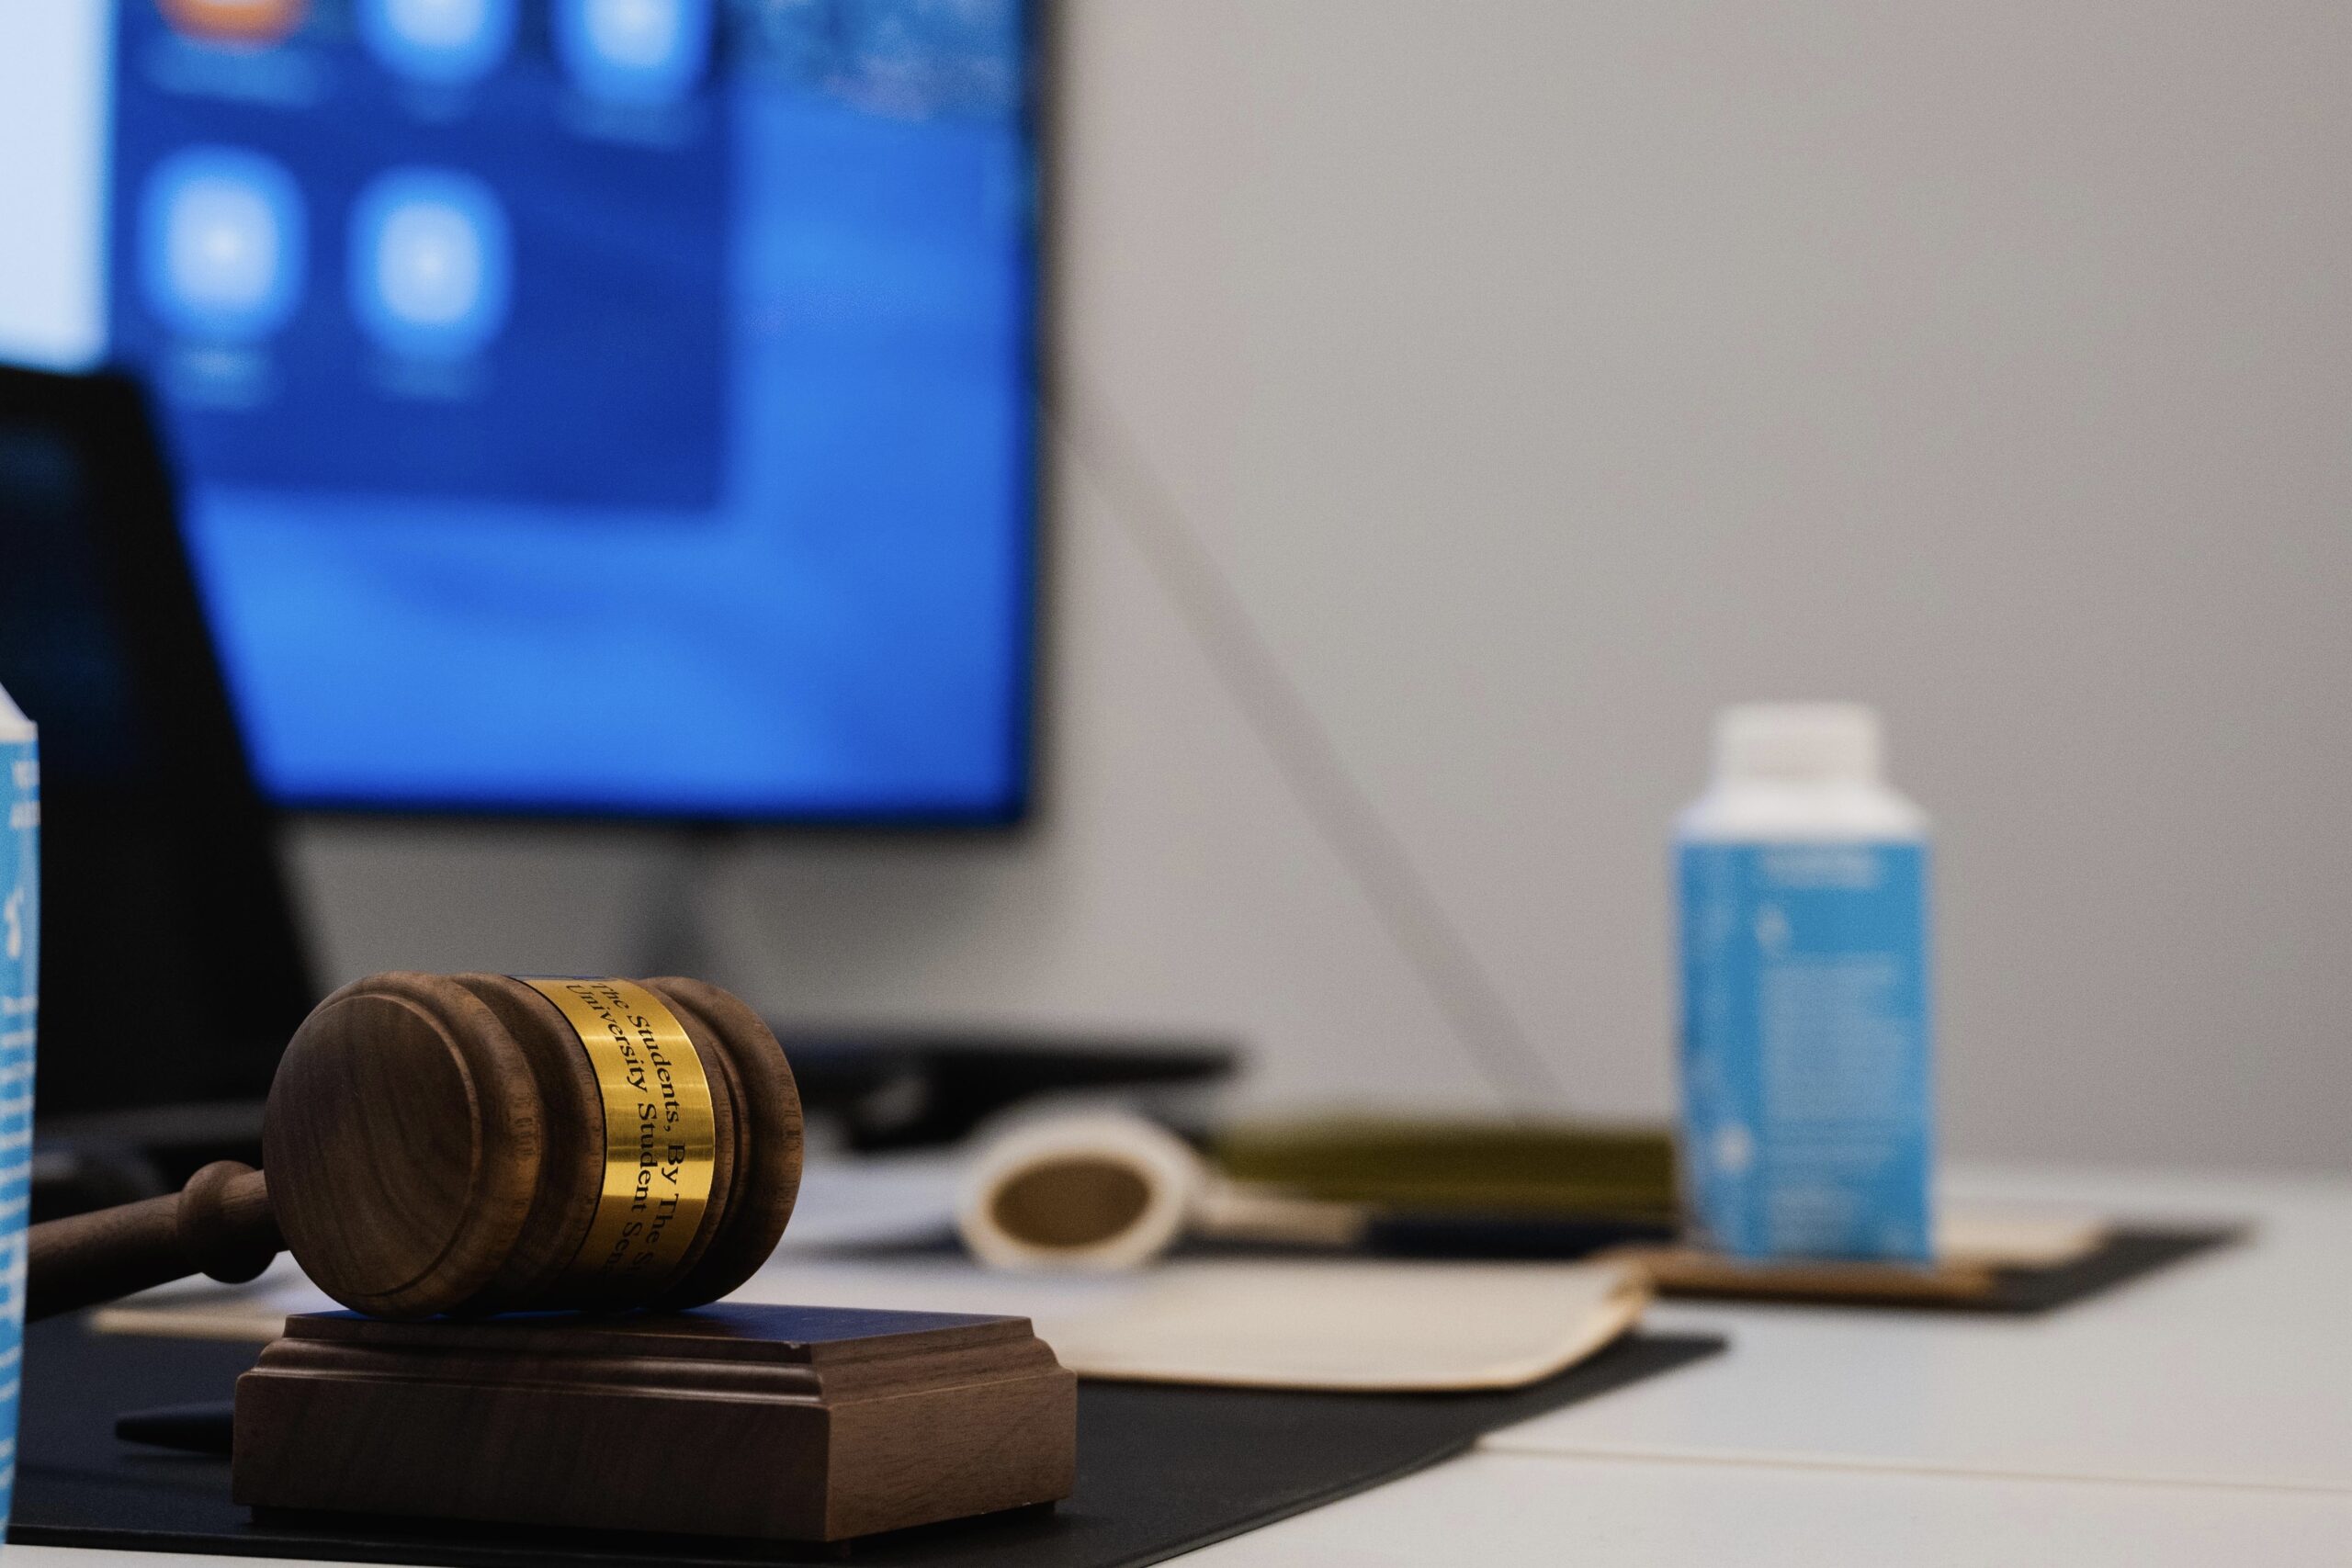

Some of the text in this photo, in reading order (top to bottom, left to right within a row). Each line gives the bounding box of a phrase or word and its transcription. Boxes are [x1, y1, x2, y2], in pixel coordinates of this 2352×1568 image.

[588, 982, 628, 1010] The
[566, 984, 647, 1093] University
[631, 1101, 658, 1213] Student
[627, 1014, 680, 1134] Students,
[662, 1142, 685, 1185] By
[645, 1193, 678, 1244] The
